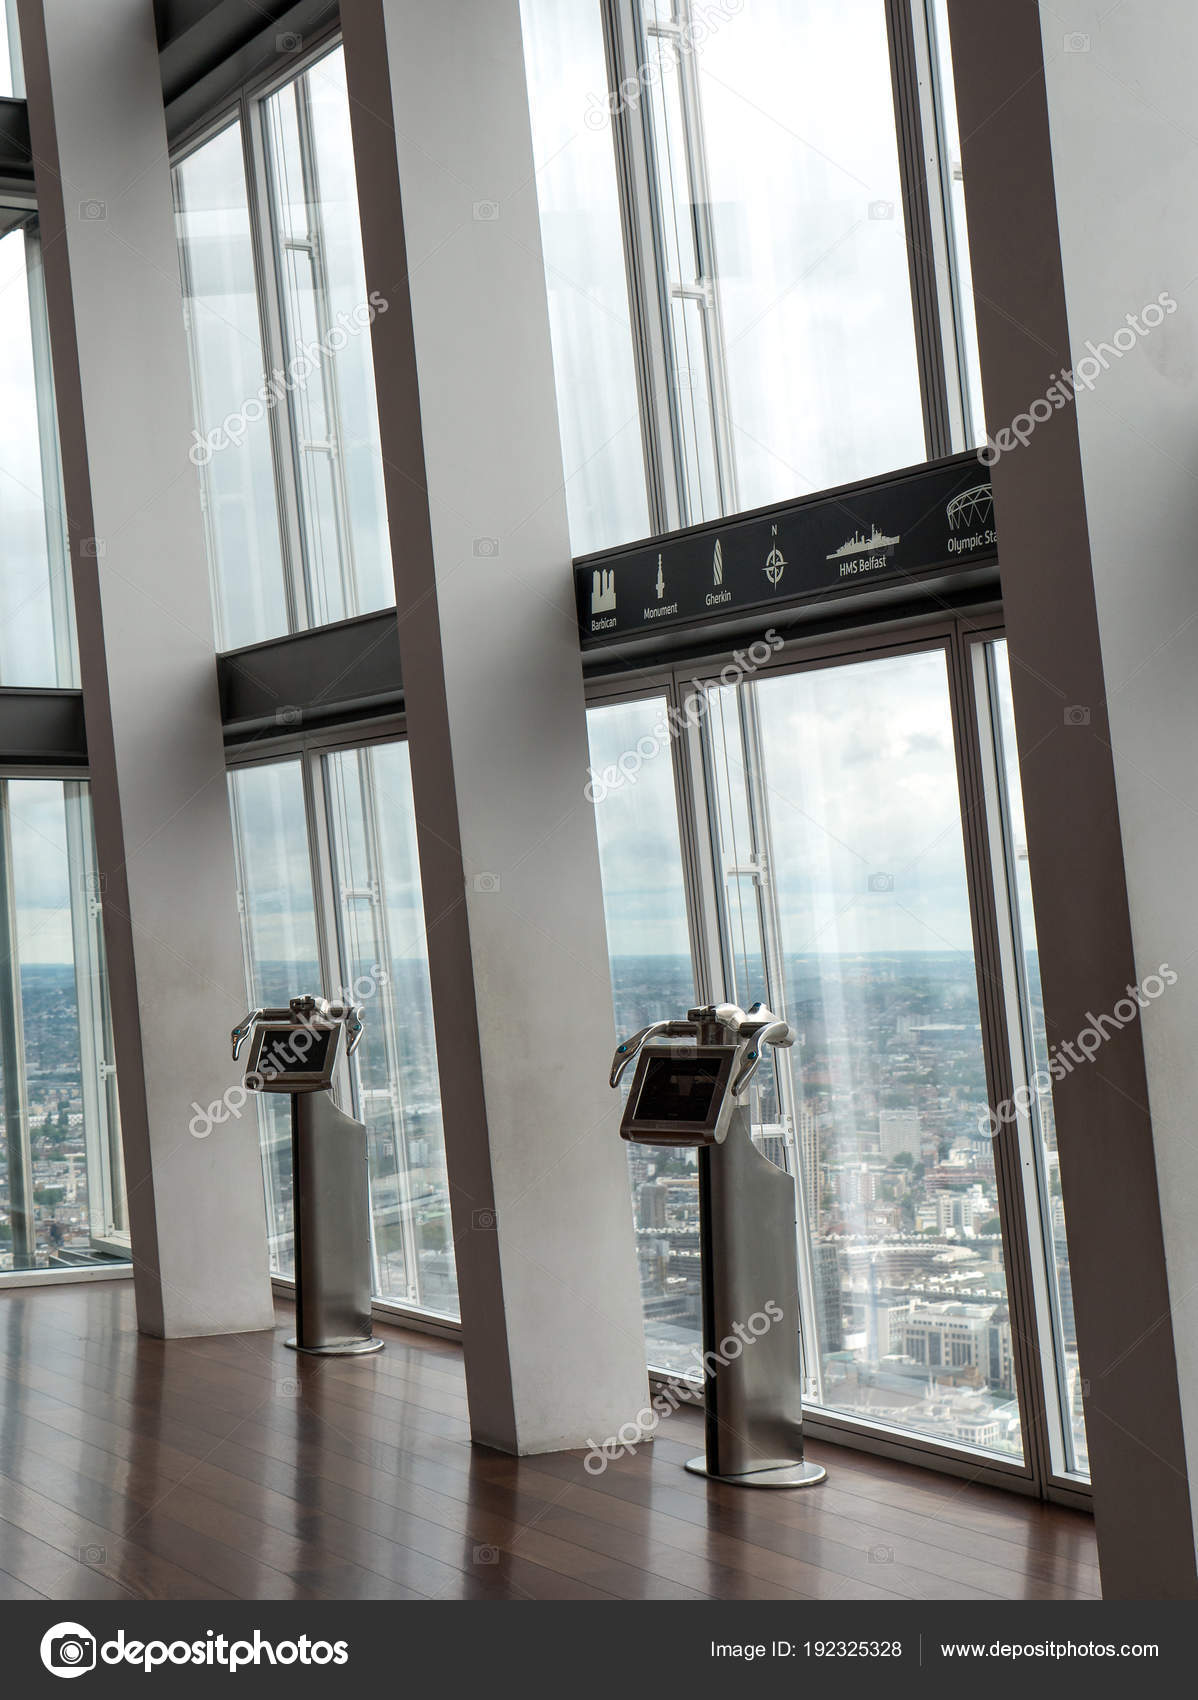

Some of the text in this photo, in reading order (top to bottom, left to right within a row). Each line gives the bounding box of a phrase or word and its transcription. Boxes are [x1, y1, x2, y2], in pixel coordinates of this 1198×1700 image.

[771, 524, 778, 536] N
[947, 532, 983, 554] Olympic
[840, 554, 887, 577] HMS Belfast
[705, 590, 732, 606] Gherkin
[643, 602, 678, 620] Monument
[591, 616, 617, 632] Barbican
